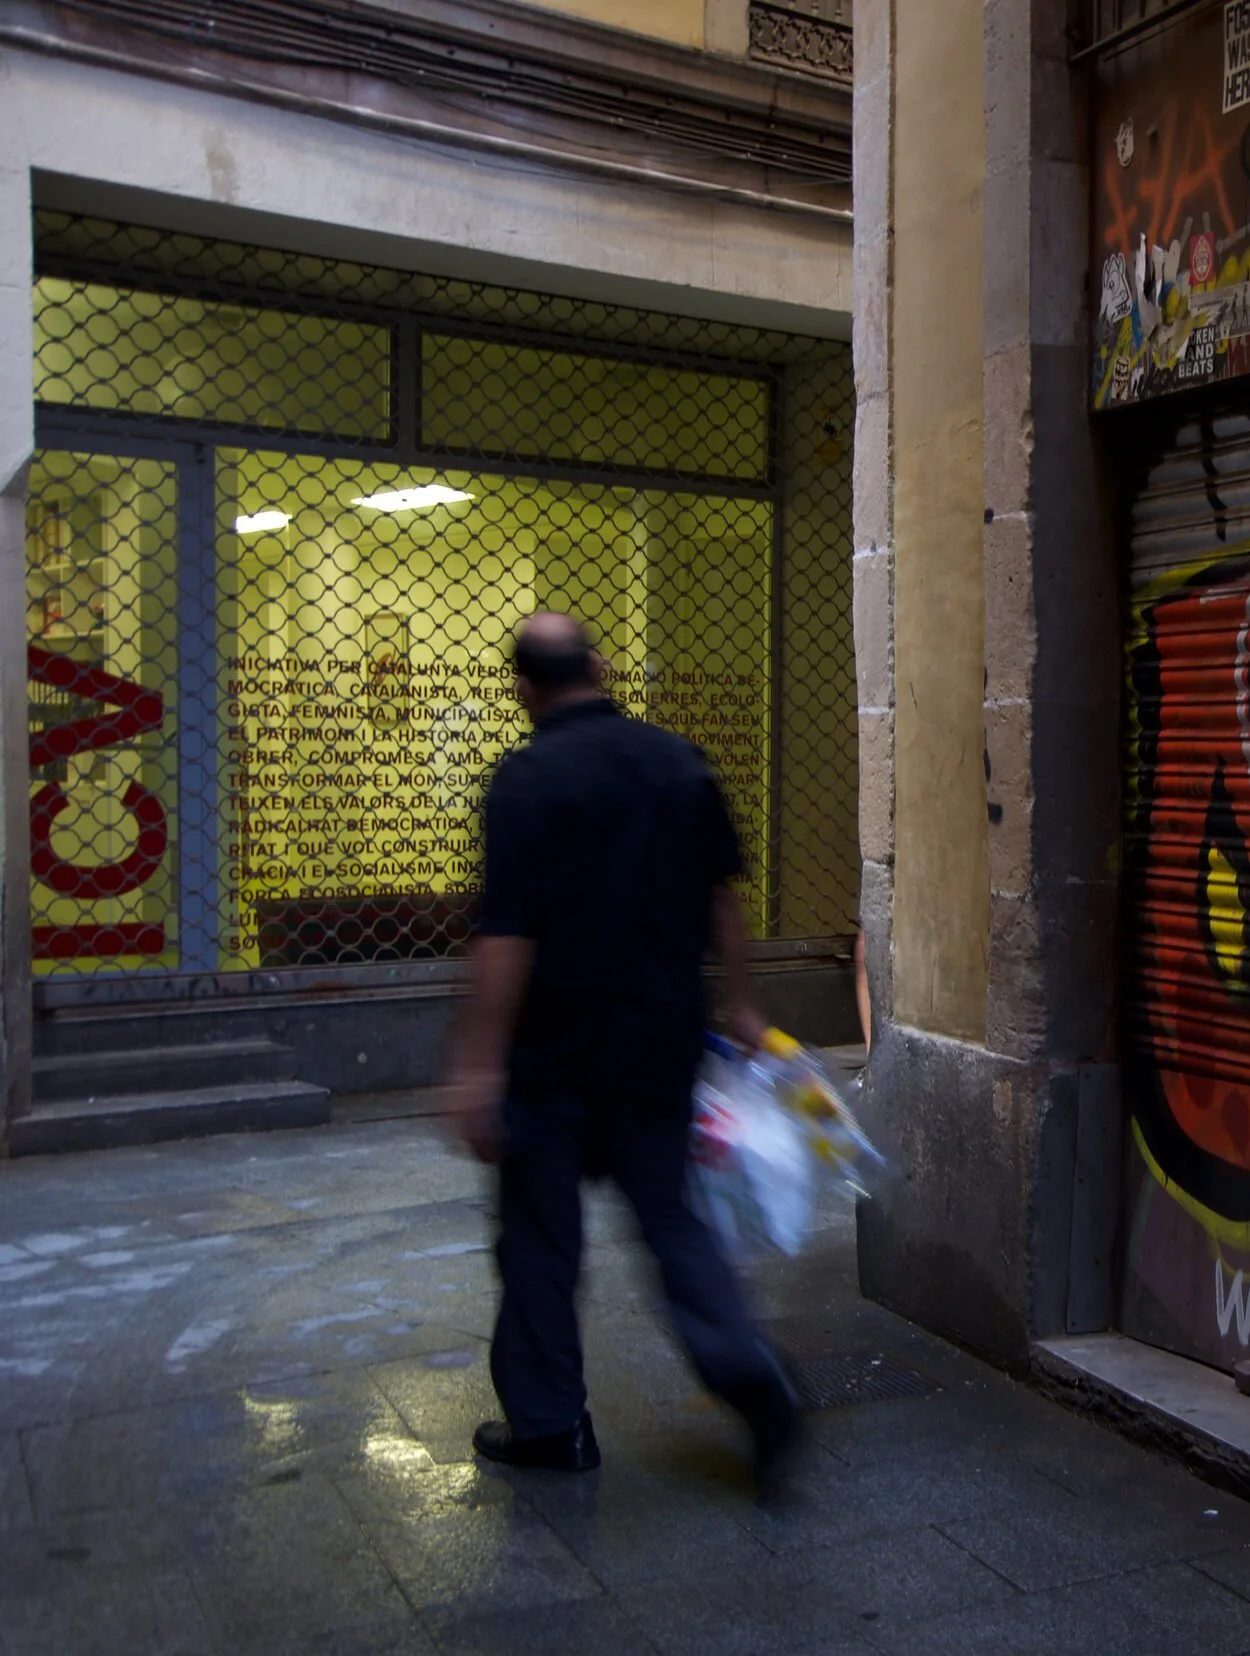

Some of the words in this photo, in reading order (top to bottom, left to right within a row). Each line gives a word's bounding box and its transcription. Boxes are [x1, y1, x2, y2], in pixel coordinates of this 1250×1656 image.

[1190, 326, 1215, 345] OKEN
[1186, 343, 1214, 362] AND
[1178, 359, 1214, 378] BEATS
[228, 657, 320, 671] INICIATIVA
[328, 660, 361, 673] PER
[368, 661, 460, 677] CATALUNYA
[467, 663, 520, 680] VERDS
[228, 703, 287, 720] GISTA,
[292, 705, 391, 723] FEMINISTA,
[397, 708, 525, 724] MUNICIPALISTA,
[702, 713, 728, 726] FAN
[228, 727, 248, 740] EL
[257, 727, 354, 741] PATRIMONI
[373, 729, 392, 742] LA
[483, 731, 513, 743] DEL
[228, 750, 298, 766] OBRER,
[309, 750, 436, 765] COMPROMESA
[447, 752, 483, 765] AMB
[715, 754, 760, 766] VOLEN
[228, 773, 367, 787] TRANSFORMAR
[374, 773, 393, 787] EL
[228, 796, 296, 810] TEIXEN
[301, 796, 334, 810] ELS
[339, 796, 405, 809] VALORS
[411, 796, 433, 809] DE
[438, 796, 457, 809] LA
[228, 820, 339, 833] RADICALITAT
[229, 843, 278, 857] RITAT
[297, 842, 335, 856] QUE
[341, 841, 374, 854] VOL
[382, 839, 479, 853] CONSTRUIR
[338, 861, 443, 877] SOCIALISME
